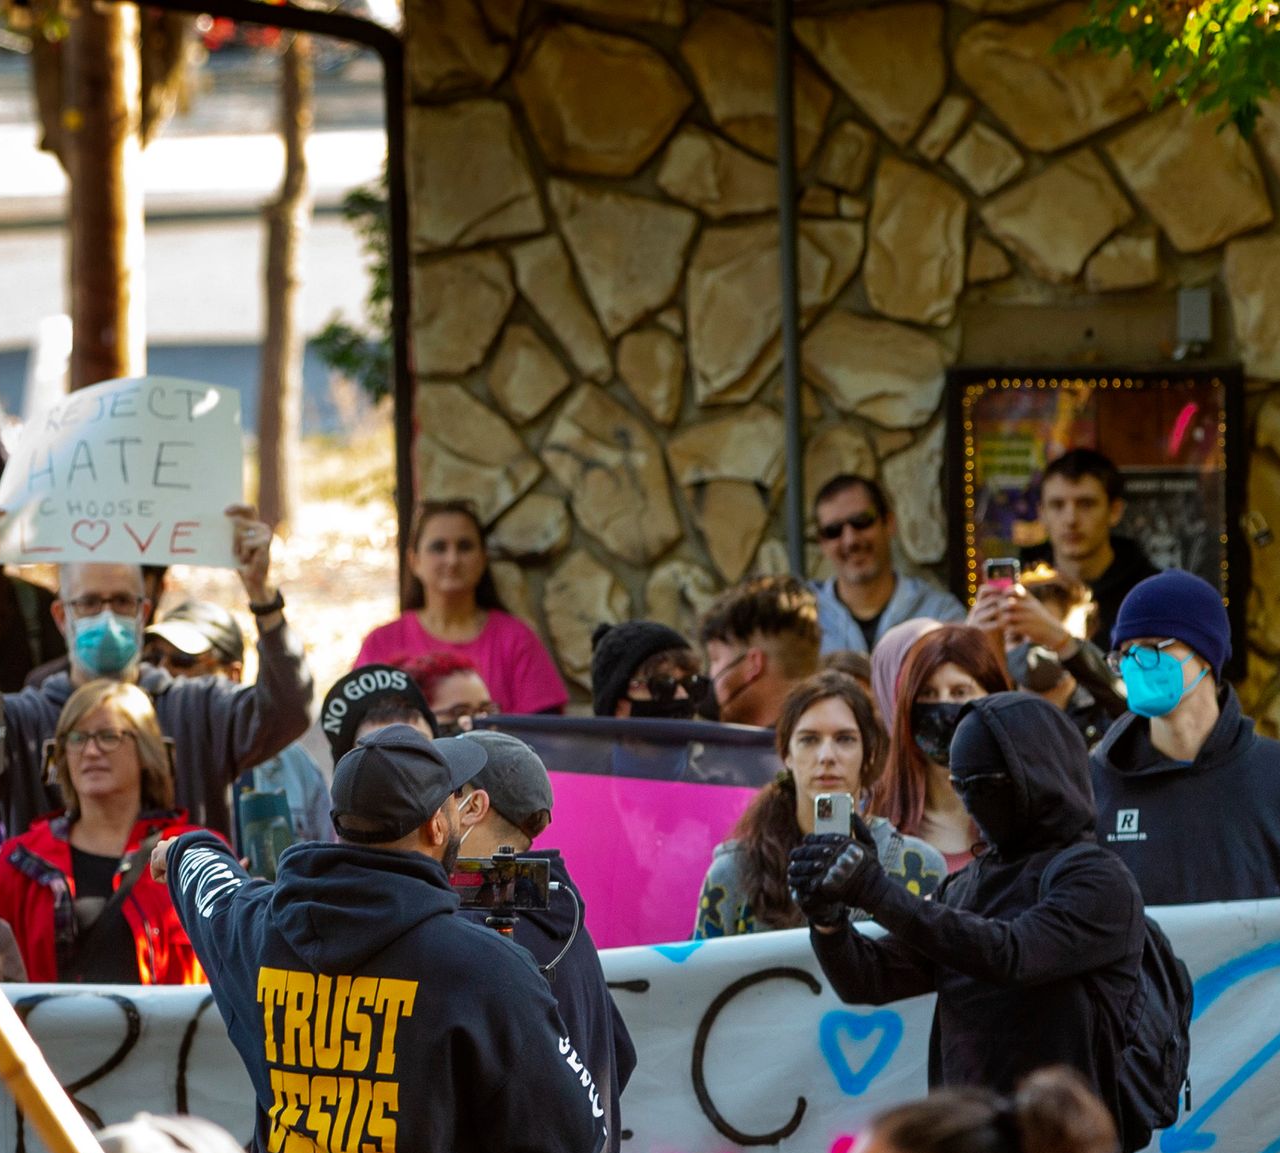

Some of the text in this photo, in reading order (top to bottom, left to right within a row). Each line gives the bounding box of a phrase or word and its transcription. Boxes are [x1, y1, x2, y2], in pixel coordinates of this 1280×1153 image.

[26, 436, 196, 492] HATE
[38, 498, 156, 518] CHOOSE
[323, 669, 408, 736] NO GODS
[256, 965, 419, 1076] TRUST
